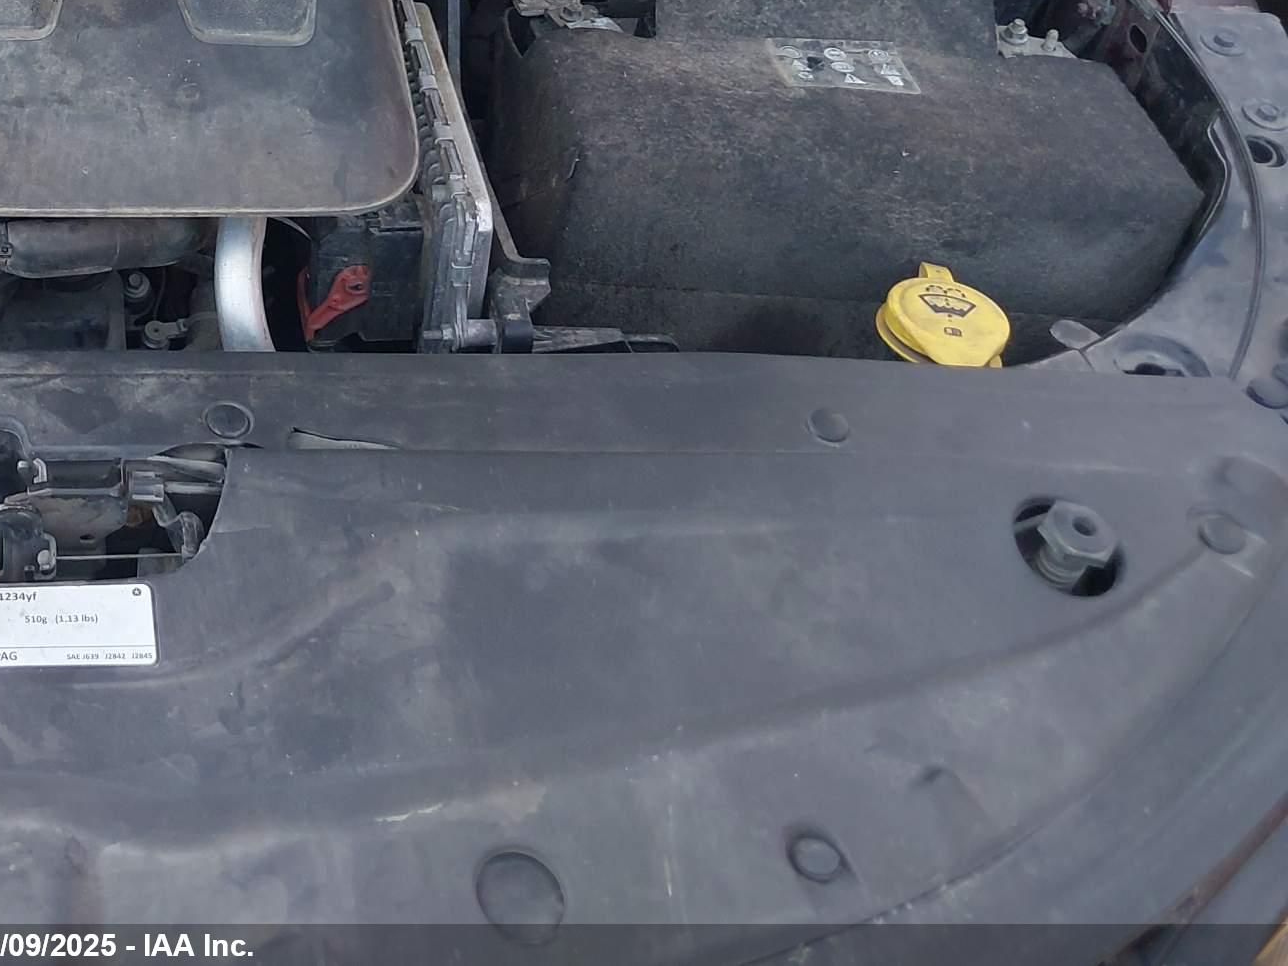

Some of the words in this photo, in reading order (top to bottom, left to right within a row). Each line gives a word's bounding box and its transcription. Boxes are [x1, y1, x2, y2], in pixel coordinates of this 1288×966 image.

[24, 614, 48, 625] 510g
[55, 613, 79, 625] (1.13
[81, 613, 99, 624] lbs)
